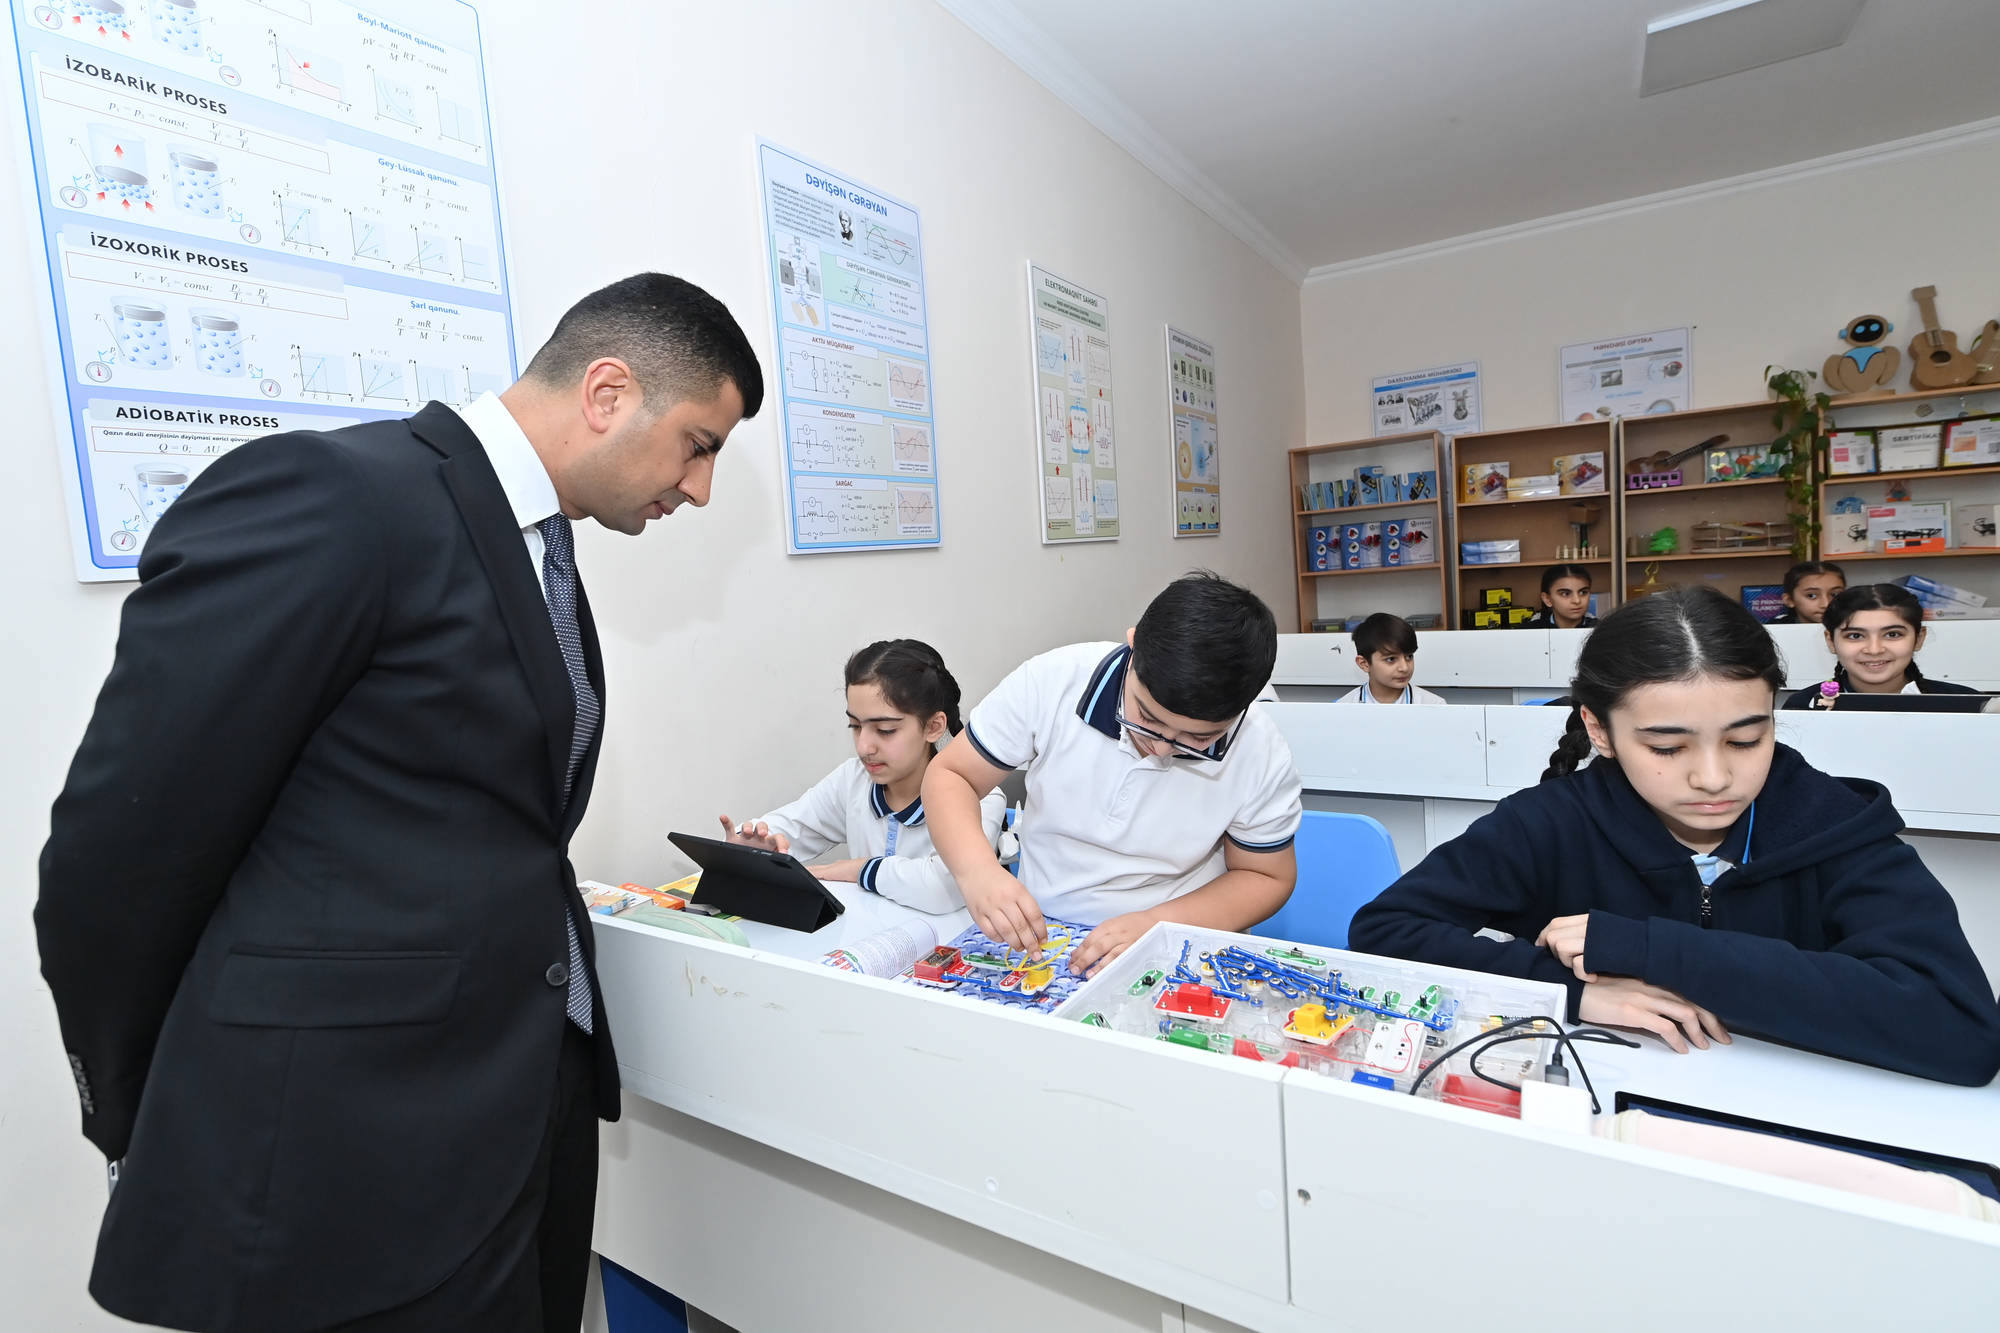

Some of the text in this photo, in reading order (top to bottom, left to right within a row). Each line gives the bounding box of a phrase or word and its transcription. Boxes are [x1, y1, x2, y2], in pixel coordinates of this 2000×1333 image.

[357, 13, 412, 41] Boyl-Mariott
[65, 54, 228, 115] İZOBARİK PROSES
[805, 173, 846, 200] DƏYİŞƏN
[848, 192, 888, 217] CƏRƏYAN
[90, 232, 249, 273] İZOXORİK PROSES
[116, 406, 280, 428] ADİOBATİK PROSES
